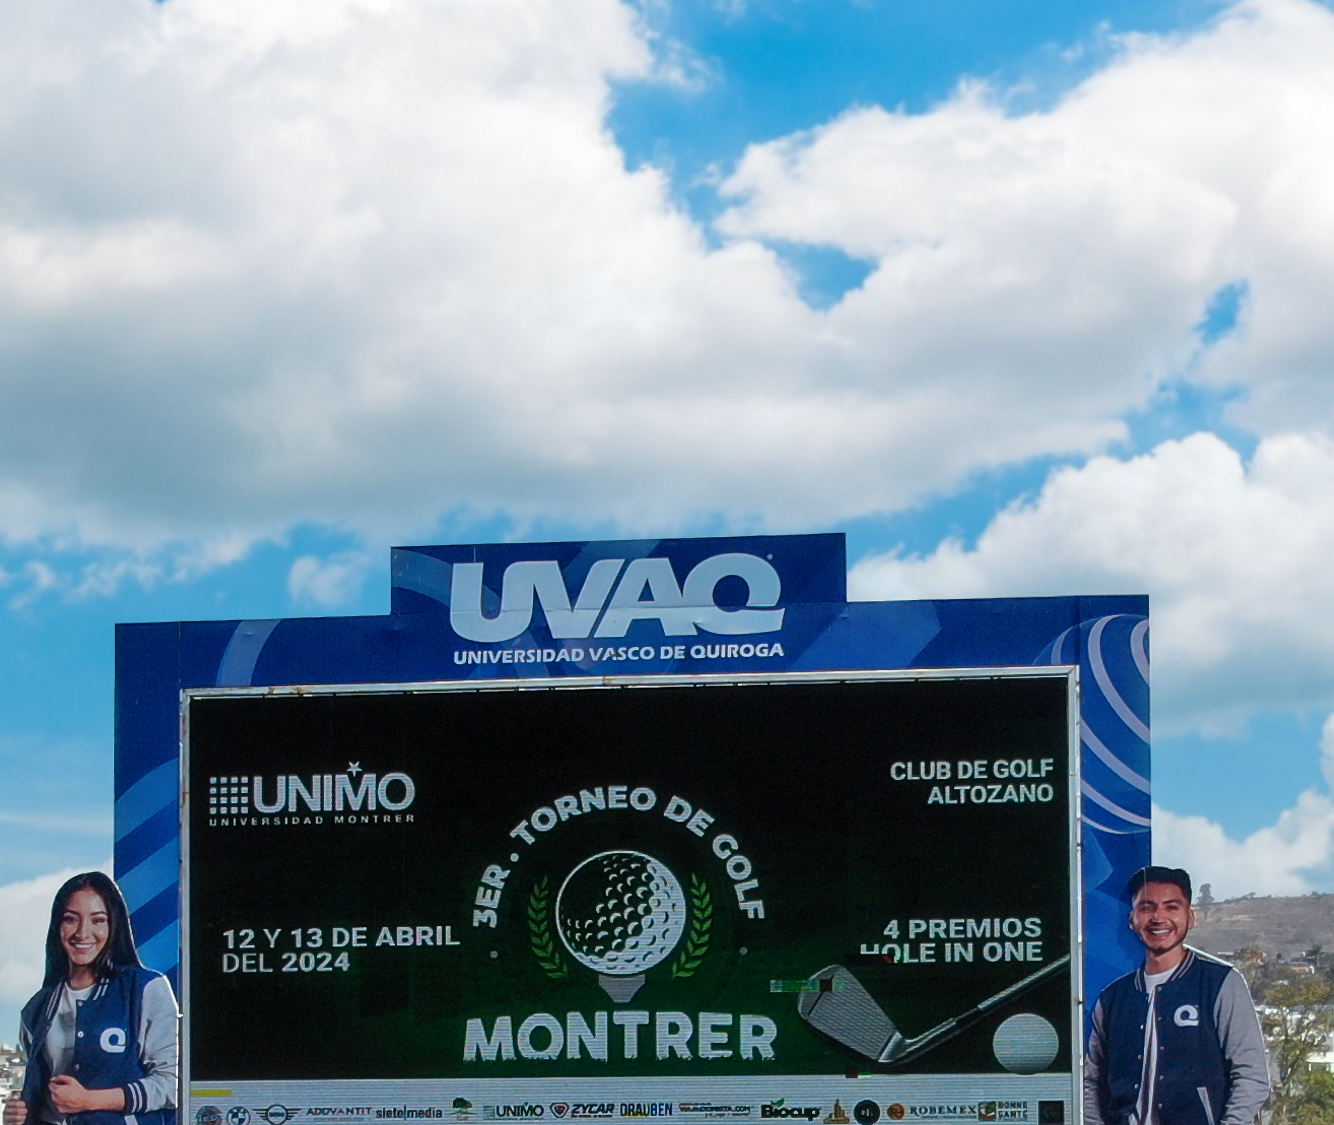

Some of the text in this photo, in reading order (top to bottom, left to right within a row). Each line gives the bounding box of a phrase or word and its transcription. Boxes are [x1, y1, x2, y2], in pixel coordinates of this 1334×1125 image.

[450, 552, 786, 643] UVAQ
[453, 642, 785, 665] UNIVERSIDAD VASCO DE QUIROGA
[890, 758, 1053, 781] CLUB DE GOLF
[253, 772, 416, 814] UNIMO
[927, 784, 1054, 804] ALTOZANO
[209, 814, 415, 827] UNIVERSIDAD MONTRER
[510, 785, 657, 846] TORNEO
[663, 795, 715, 837] DE
[712, 833, 765, 919] GOLF
[222, 926, 460, 949] 12 Y 13 DE ABRIL
[883, 917, 1042, 939] 4 PREMIOS
[222, 952, 351, 973] DEL 2024
[944, 942, 974, 963] IN
[982, 941, 1043, 962] ONE
[462, 1010, 778, 1062] MONTRER
[496, 1104, 545, 1117] UNIMO
[620, 1102, 673, 1117] DRAUBEN
[909, 1105, 977, 1117] ROBEMEX
